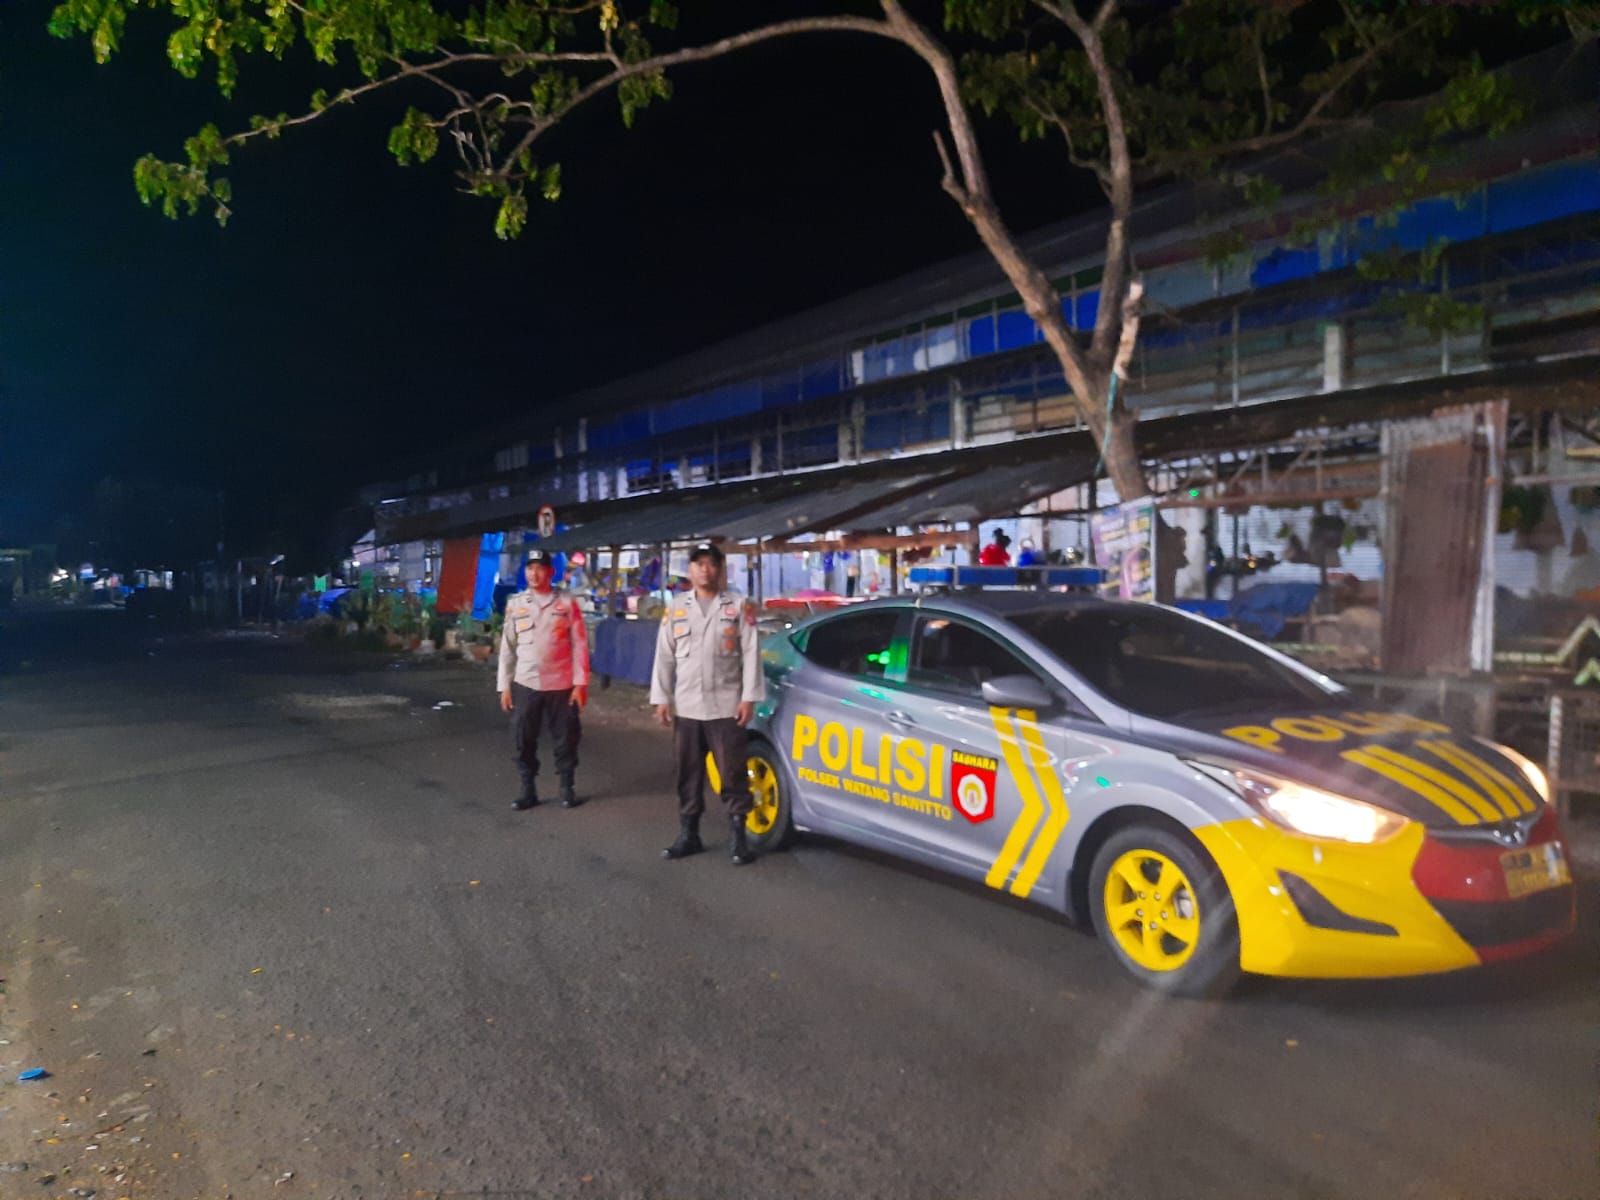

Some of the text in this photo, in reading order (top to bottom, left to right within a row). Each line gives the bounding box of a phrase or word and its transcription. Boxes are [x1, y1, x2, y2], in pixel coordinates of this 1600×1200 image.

[792, 714, 945, 799] POLISI
[798, 767, 954, 821] POLSEK WATANG SAWITTO
